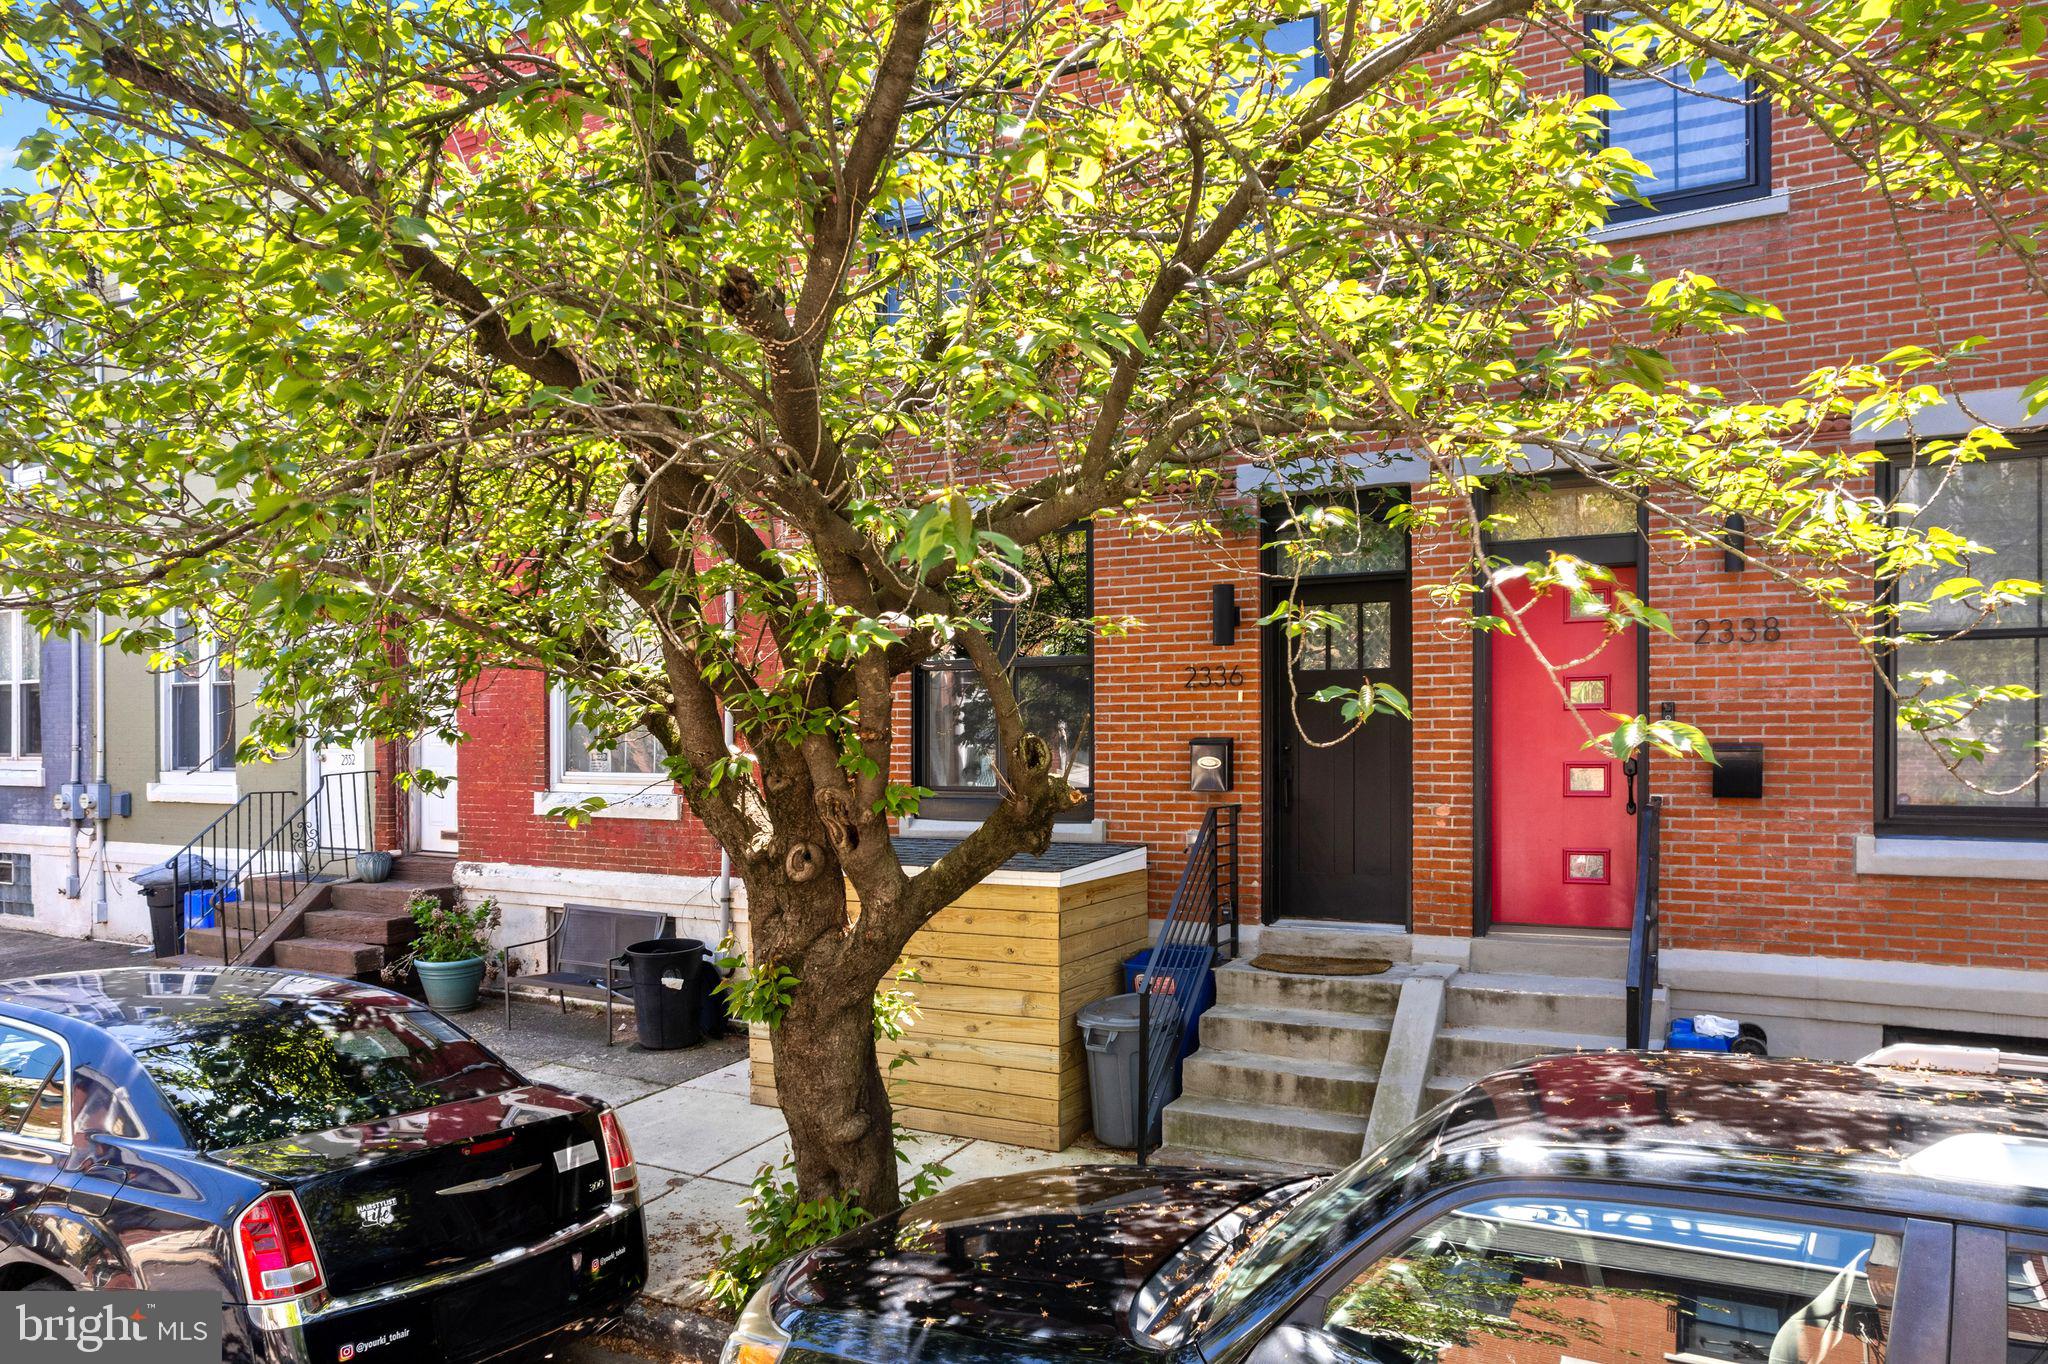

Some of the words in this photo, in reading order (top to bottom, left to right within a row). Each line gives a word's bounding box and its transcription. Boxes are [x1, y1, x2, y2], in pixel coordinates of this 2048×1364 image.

[1694, 616, 1781, 645] 2338
[1184, 664, 1244, 689] 2336
[341, 753, 356, 766] 2332
[588, 1178, 605, 1193] 300
[356, 1197, 398, 1215] HAIRSTYLIST
[360, 1205, 392, 1228] Life
[355, 1328, 410, 1353] @yourki_tohair
